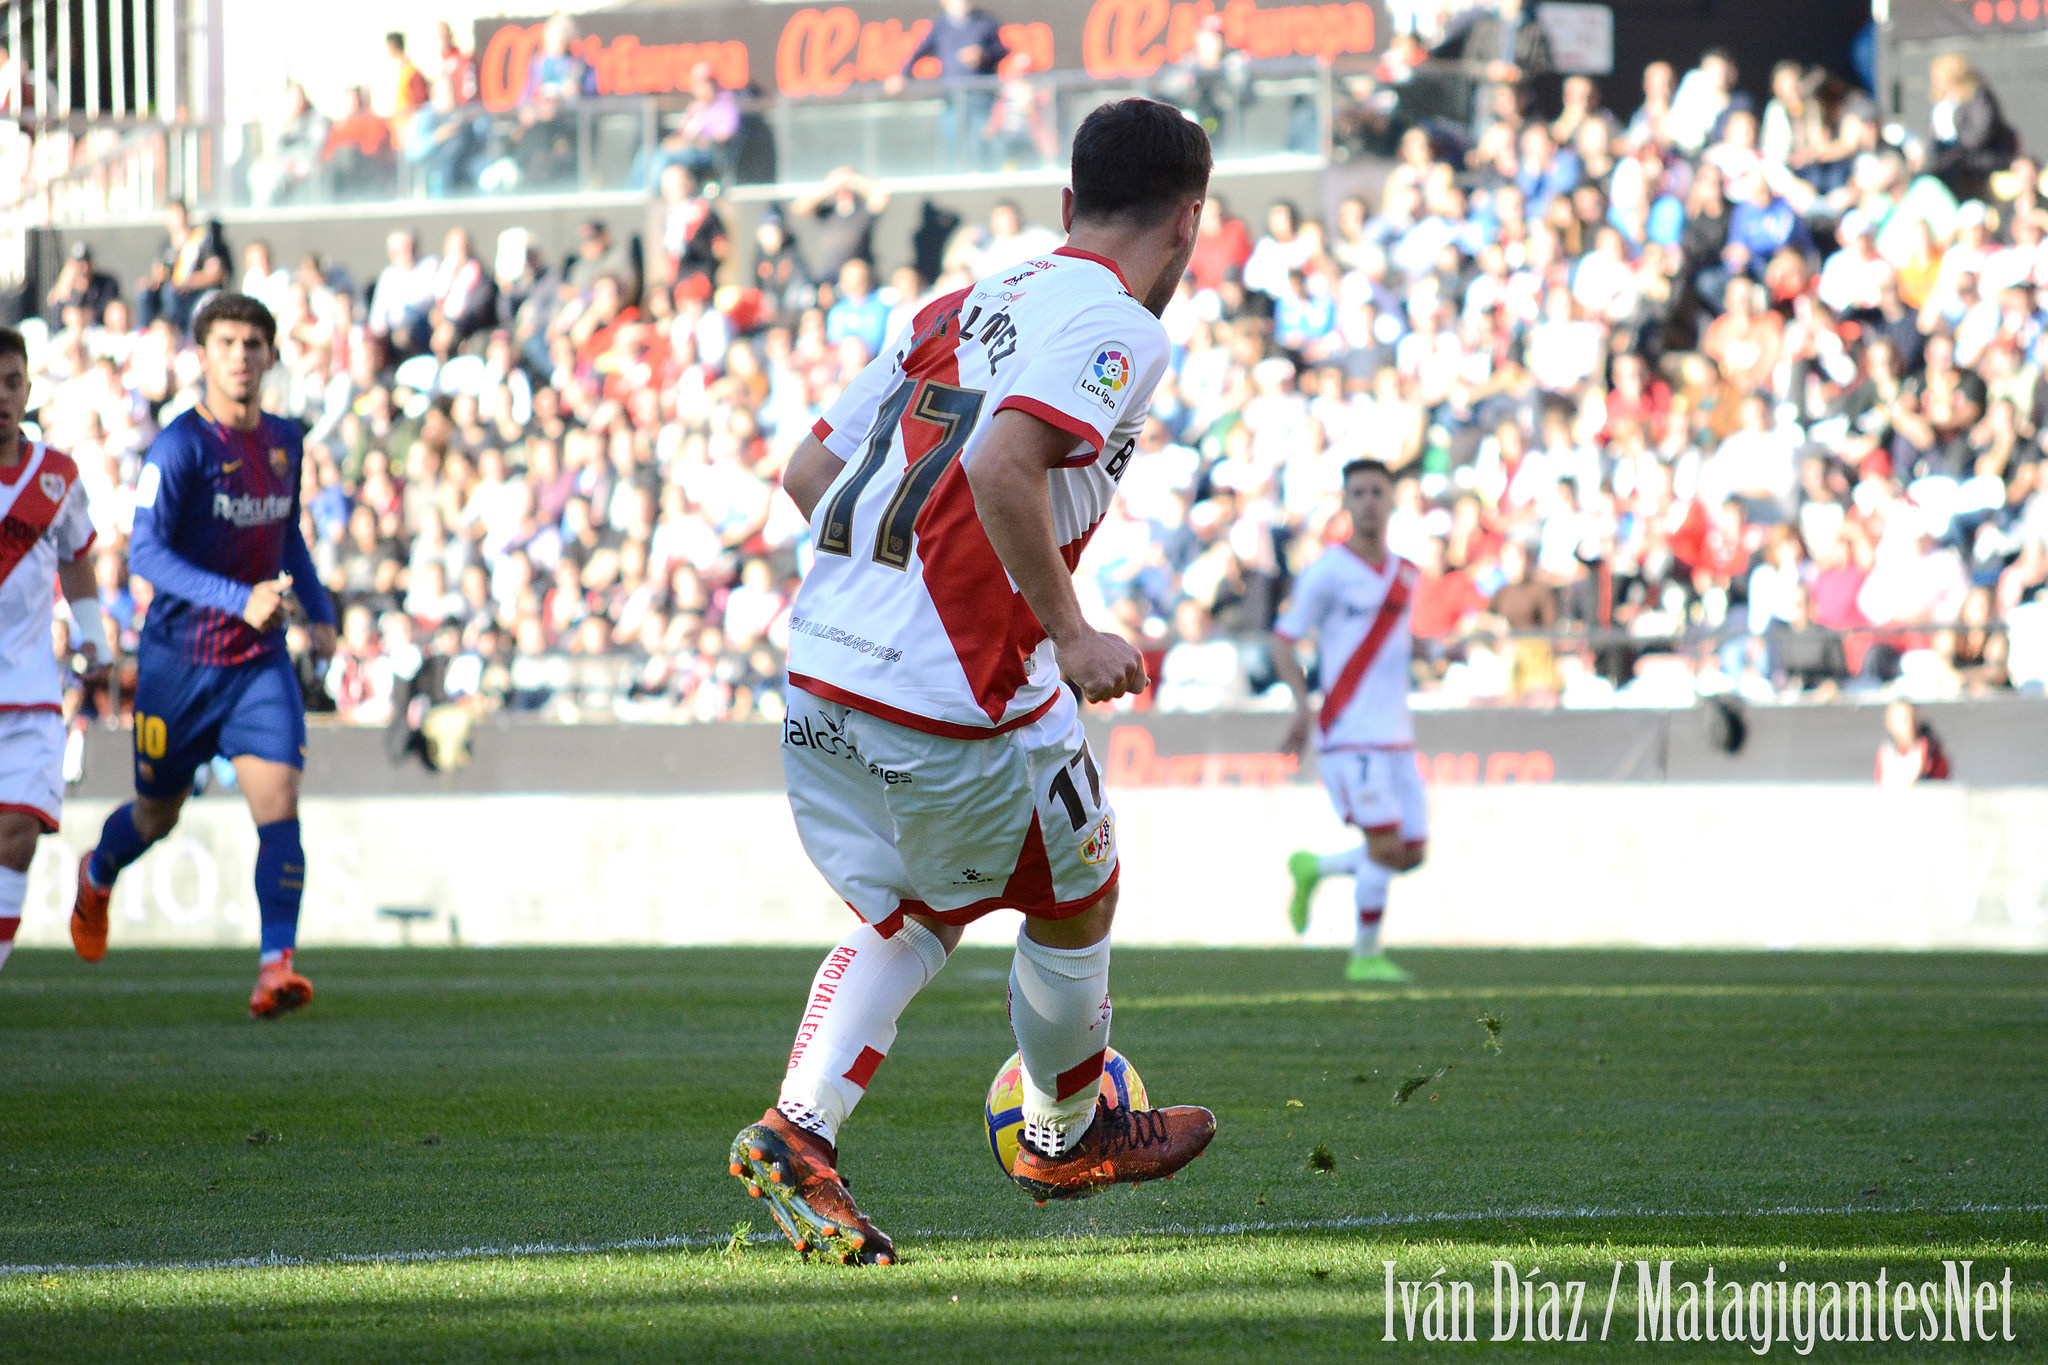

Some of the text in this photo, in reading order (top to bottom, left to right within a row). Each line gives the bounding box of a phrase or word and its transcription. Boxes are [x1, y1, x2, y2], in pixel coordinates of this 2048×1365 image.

[1081, 379, 1116, 410] LaLiga
[816, 378, 987, 571] 17
[1105, 438, 1135, 482] B
[135, 711, 167, 759] 10
[1049, 739, 1101, 833] 17
[1356, 754, 1369, 784] 7
[787, 946, 857, 1070] RAYO VALLECANO
